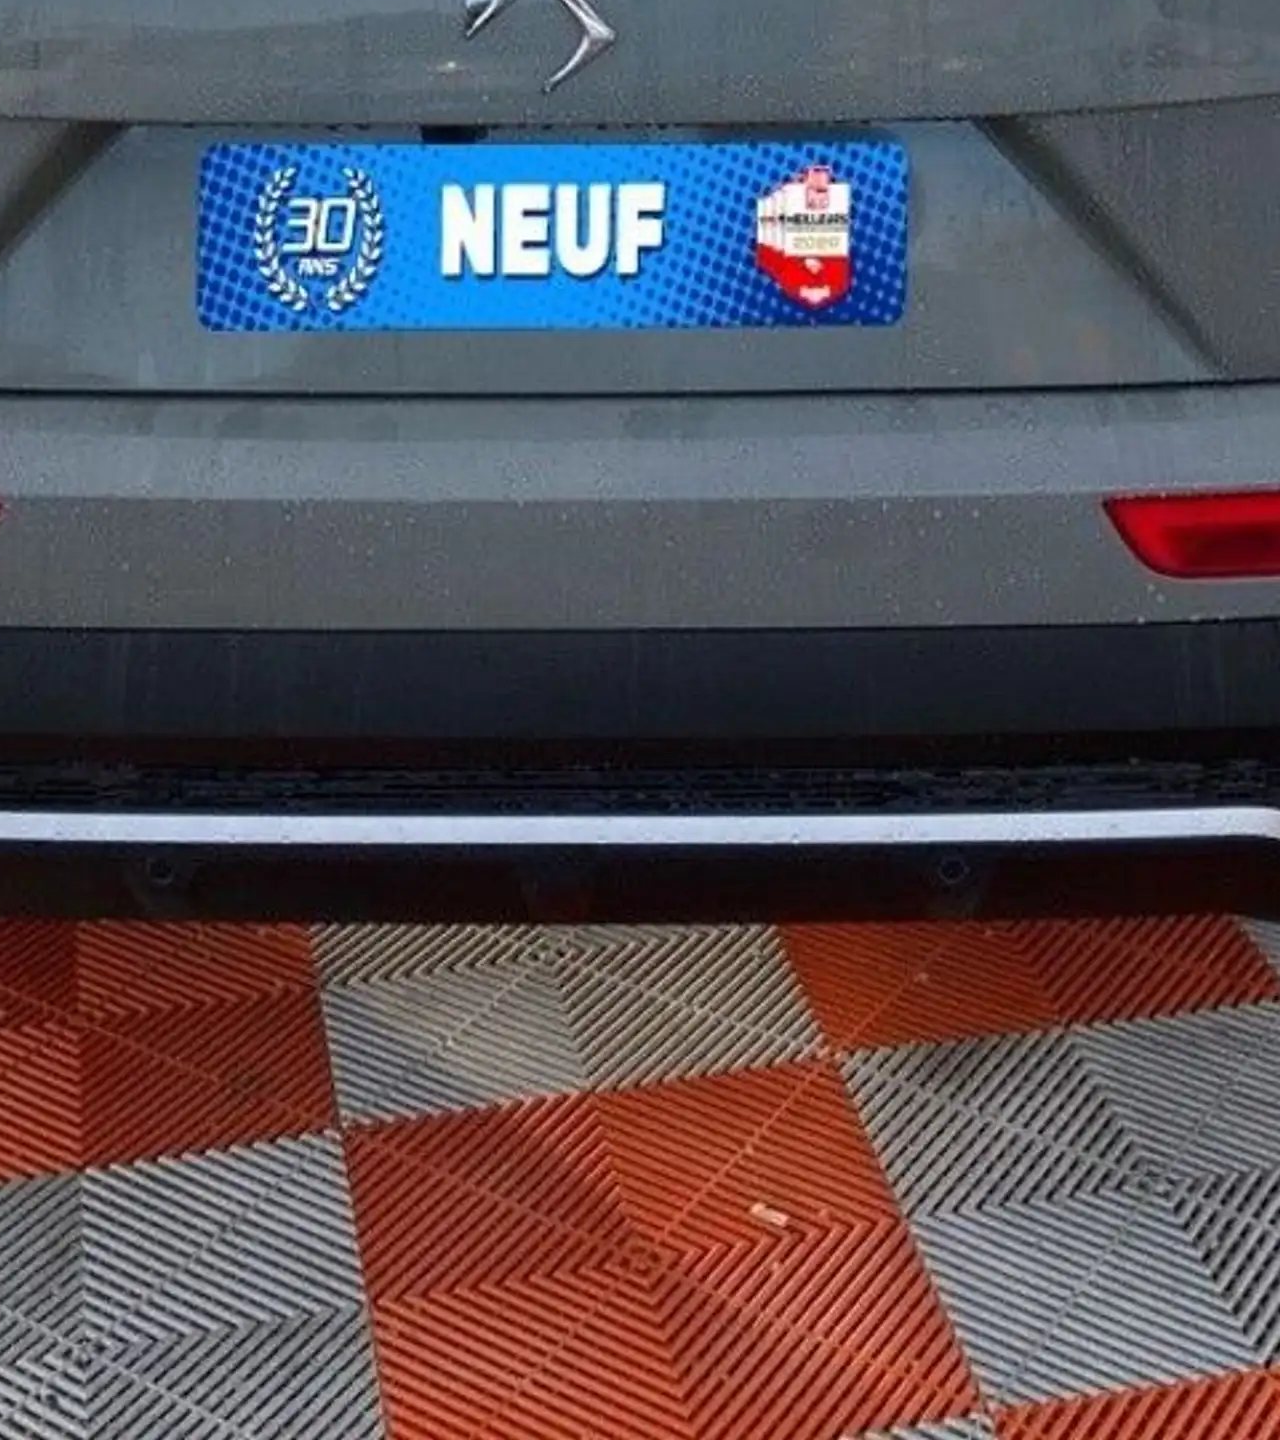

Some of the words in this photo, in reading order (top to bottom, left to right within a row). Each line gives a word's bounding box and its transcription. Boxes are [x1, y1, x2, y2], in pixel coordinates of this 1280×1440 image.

[282, 197, 357, 254] 30
[441, 182, 667, 277] NEUF
[297, 258, 341, 277] ANS
